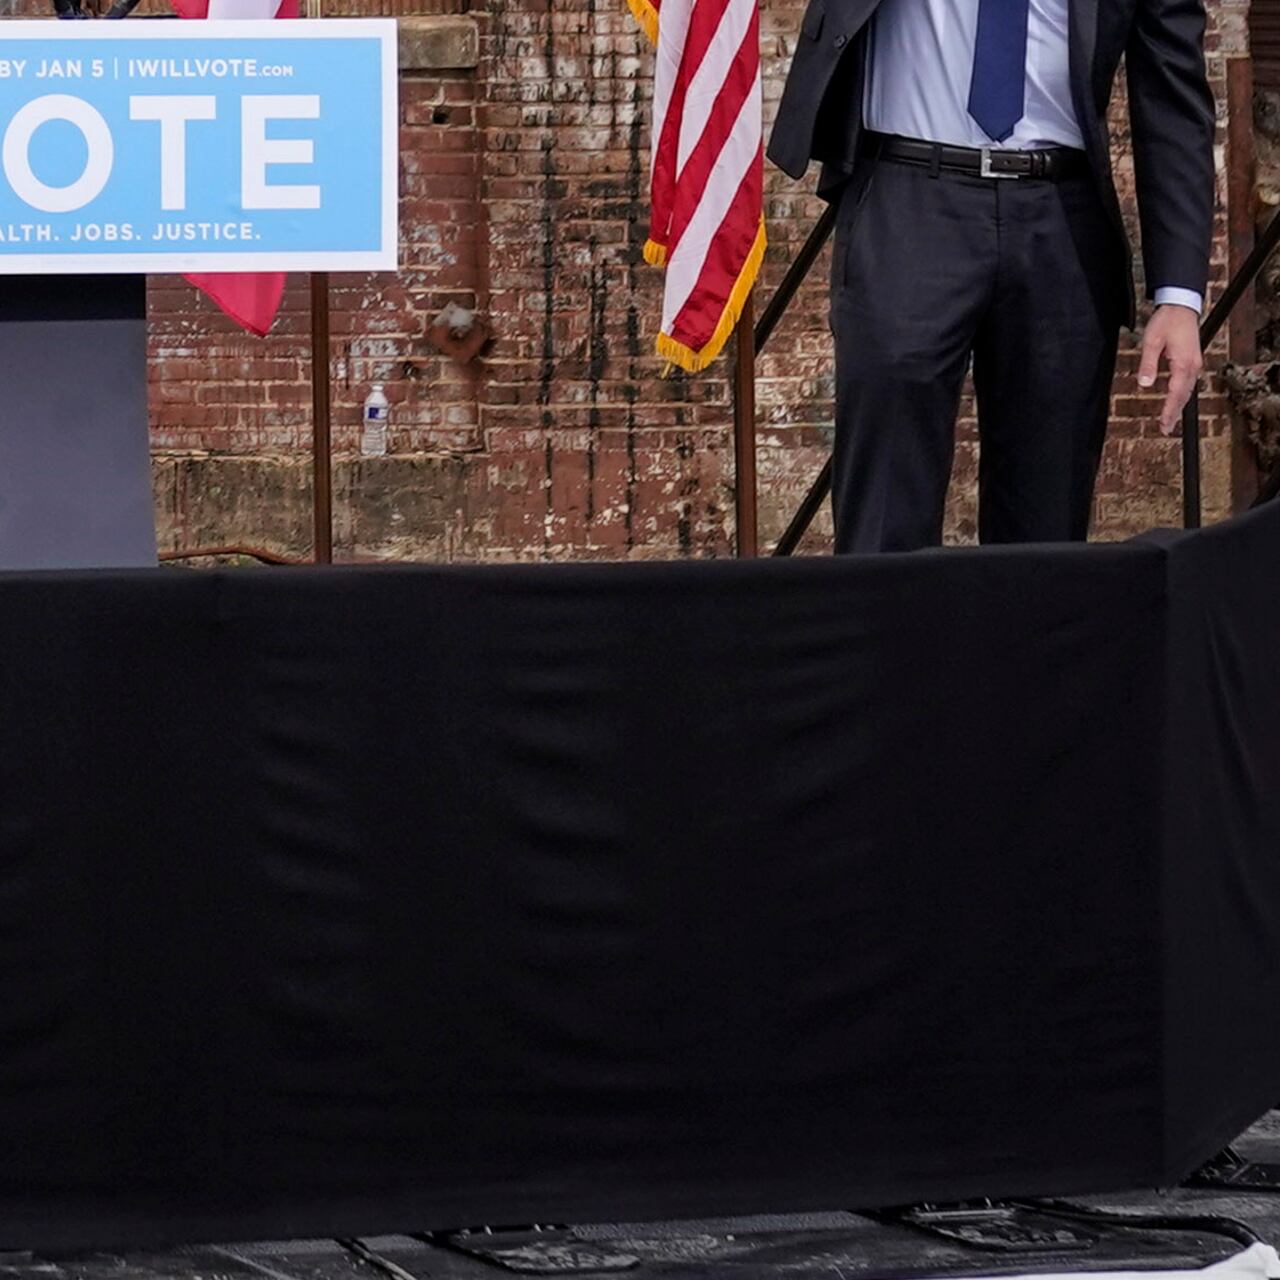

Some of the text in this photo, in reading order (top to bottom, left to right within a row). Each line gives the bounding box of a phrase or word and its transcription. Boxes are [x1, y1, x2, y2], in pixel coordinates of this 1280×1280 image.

[36, 59, 82, 78] JAN
[91, 59, 104, 78] 5
[128, 58, 293, 78] IWILLVOTE.COM
[70, 223, 141, 241] JOBS.
[152, 222, 262, 241] JUSTICE.
